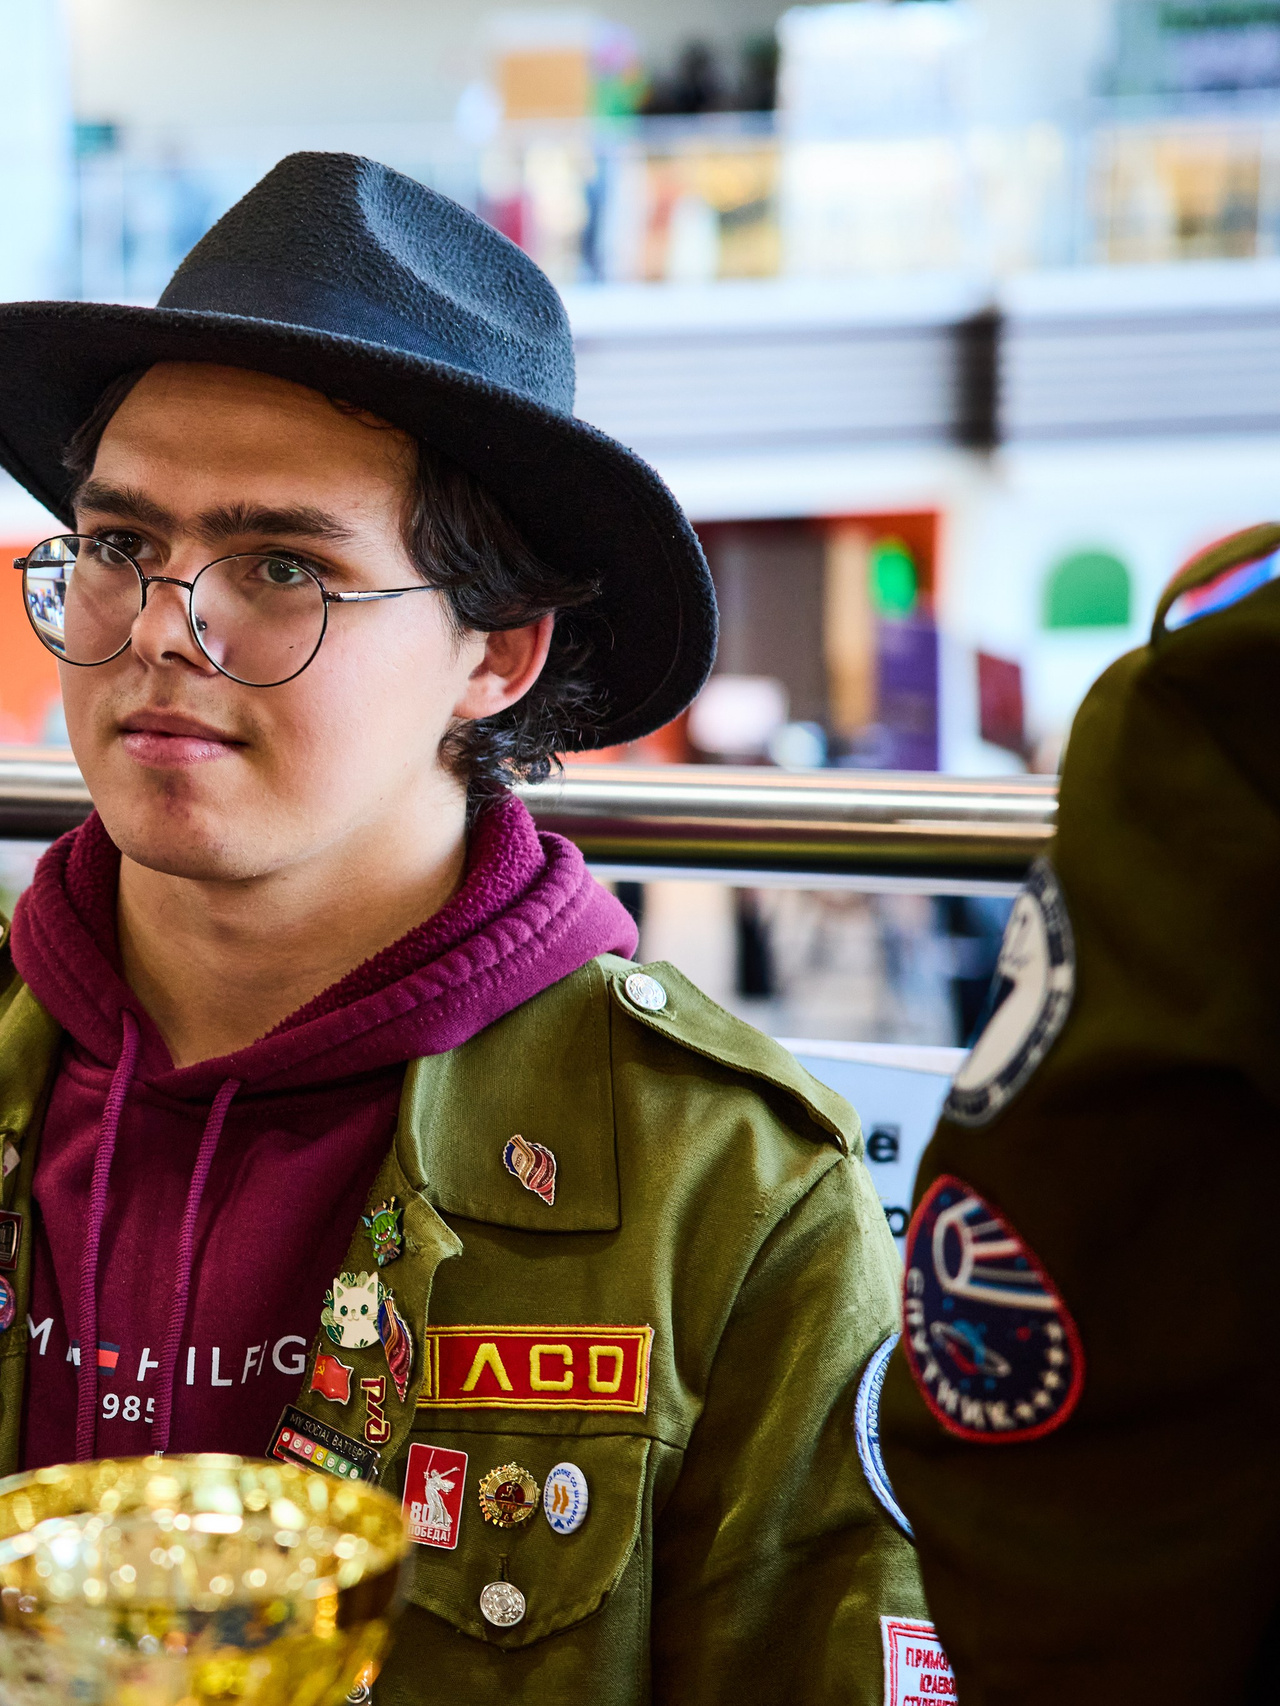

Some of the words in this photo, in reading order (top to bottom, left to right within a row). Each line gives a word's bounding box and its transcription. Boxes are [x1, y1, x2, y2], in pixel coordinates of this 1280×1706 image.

[290, 1413, 304, 1426] MY
[303, 1421, 331, 1443] SOCIAL
[410, 1501, 434, 1525] 80
[407, 1524, 451, 1543] ПОБЕДА!
